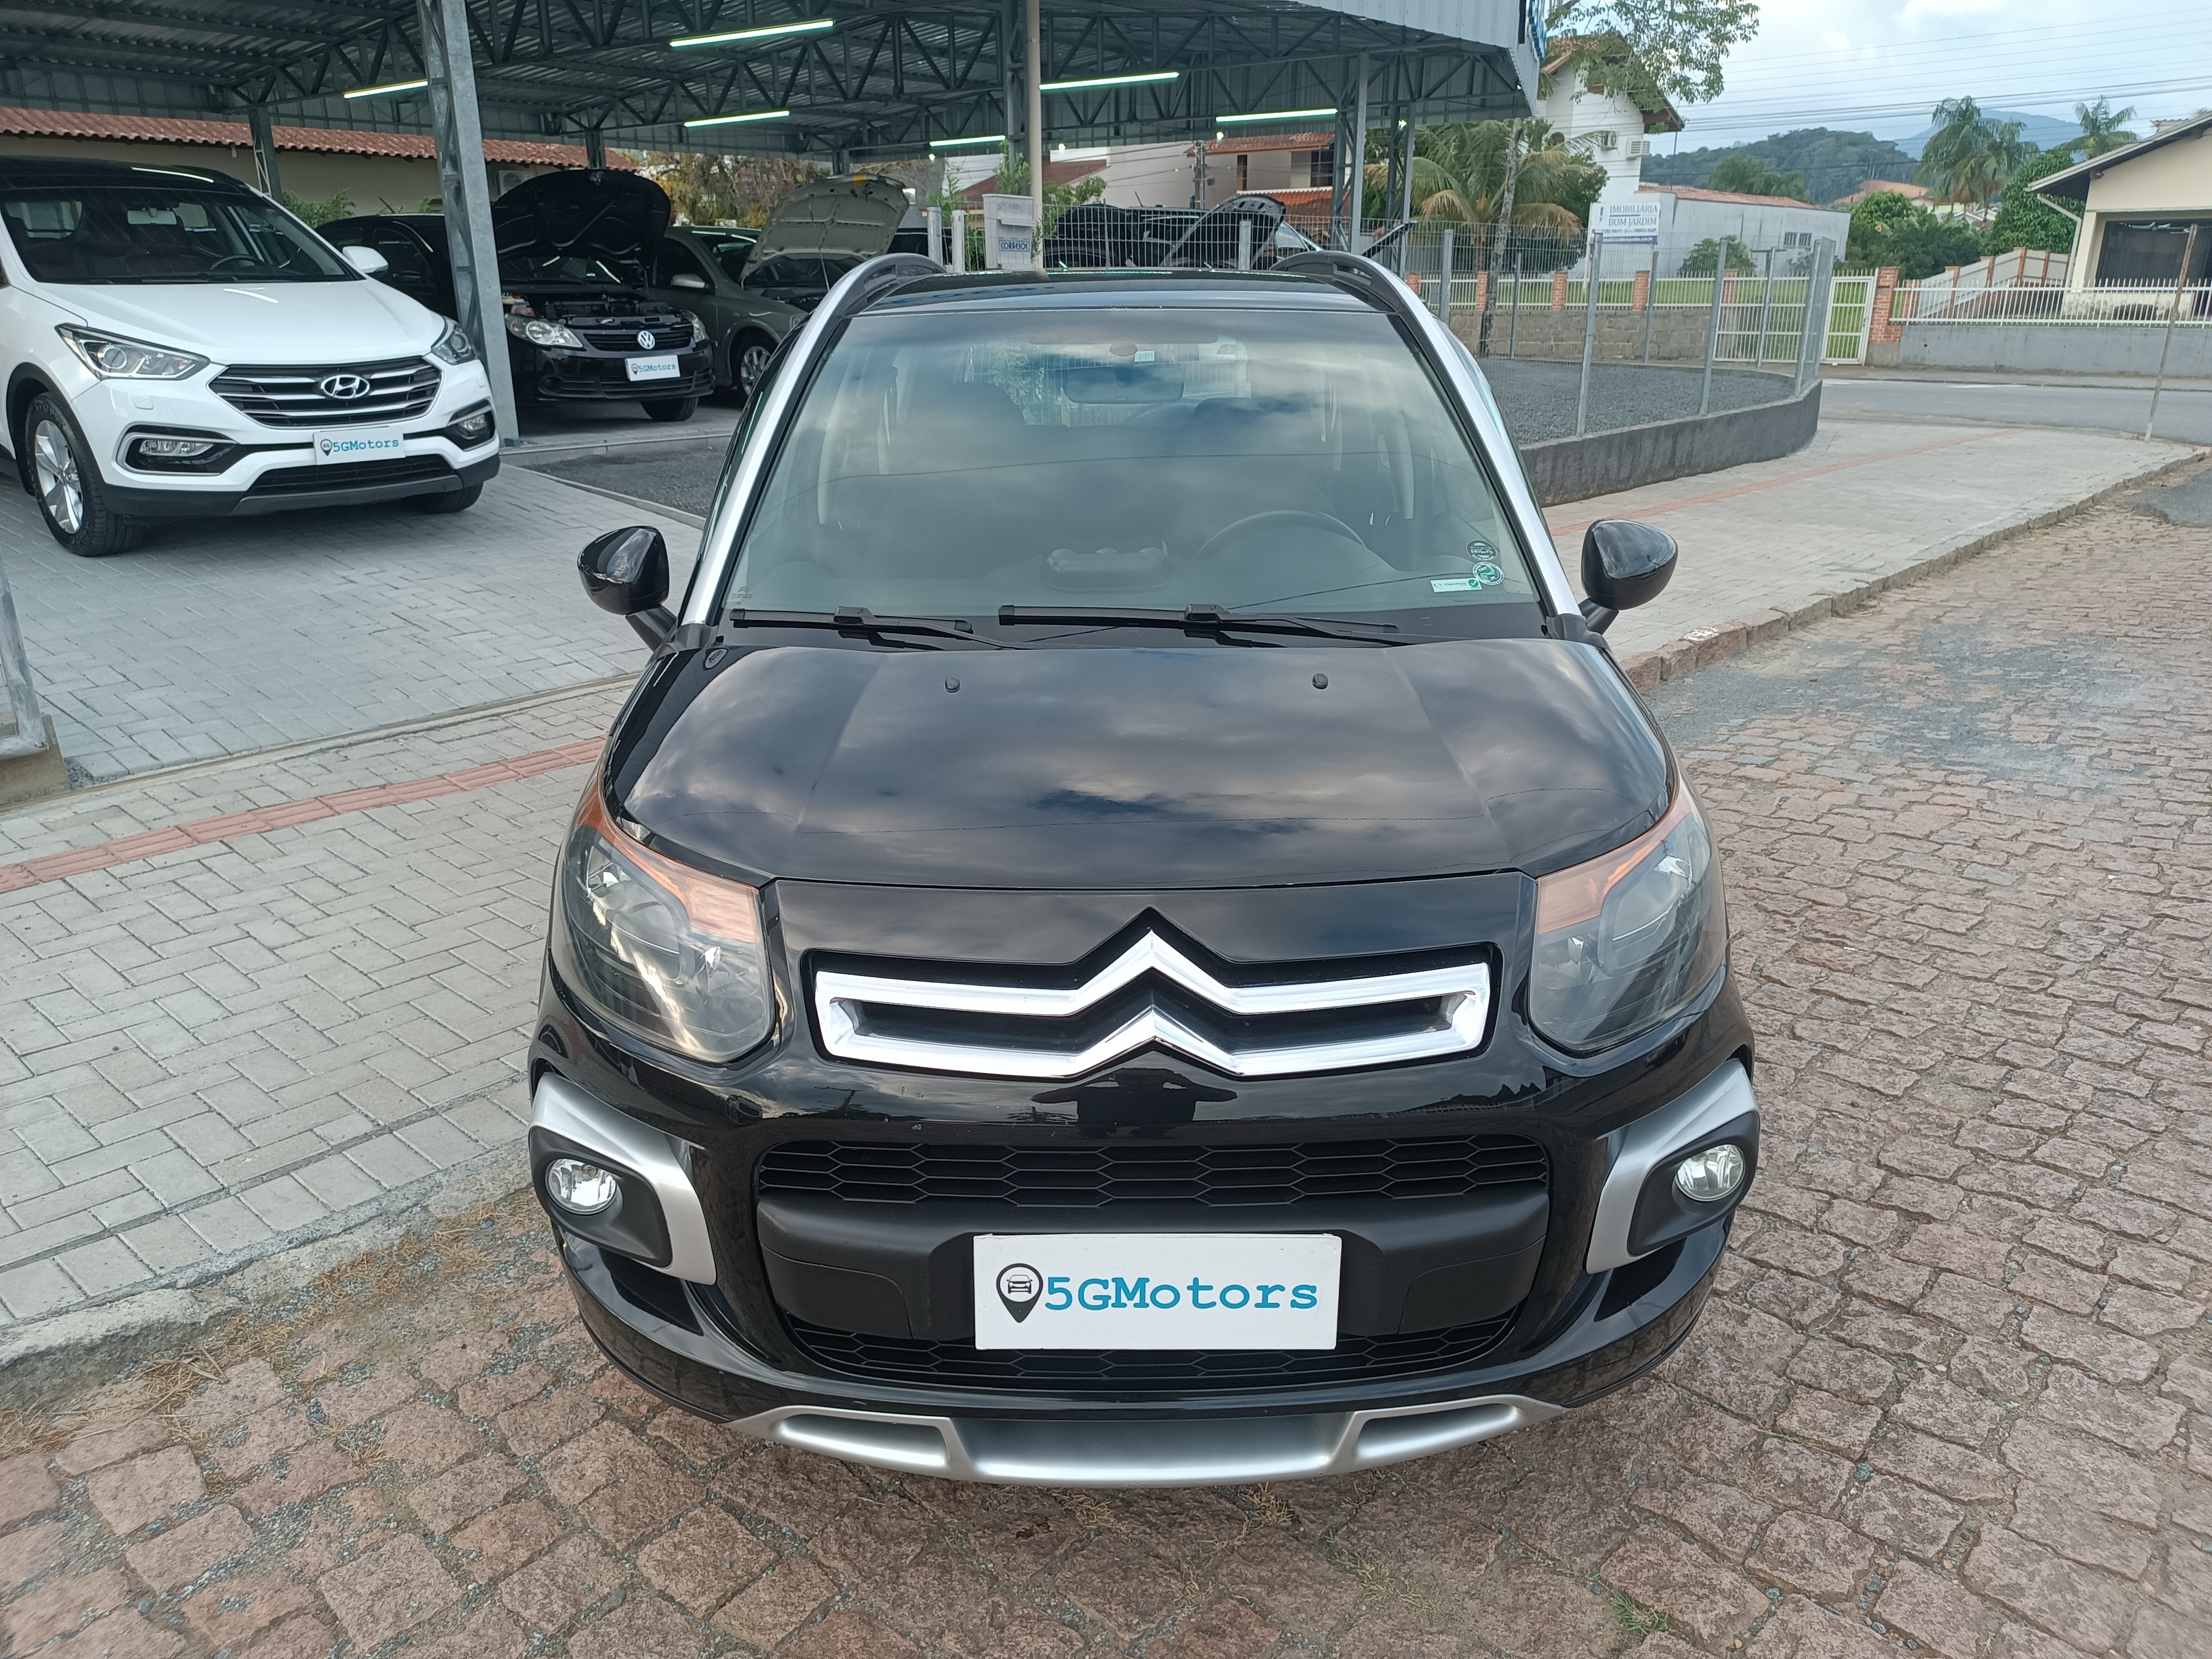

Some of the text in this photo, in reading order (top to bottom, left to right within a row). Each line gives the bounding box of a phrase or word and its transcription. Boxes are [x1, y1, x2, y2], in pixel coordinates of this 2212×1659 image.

[1610, 204, 1658, 214] IMOBILIÁRIA
[1609, 217, 1657, 227] BOM JARDIM
[1000, 242, 1029, 250] CORREIOS
[638, 364, 676, 373] 5GMotors
[333, 439, 399, 452] 5GMotors
[1045, 1276, 1317, 1311] 5GMotors
